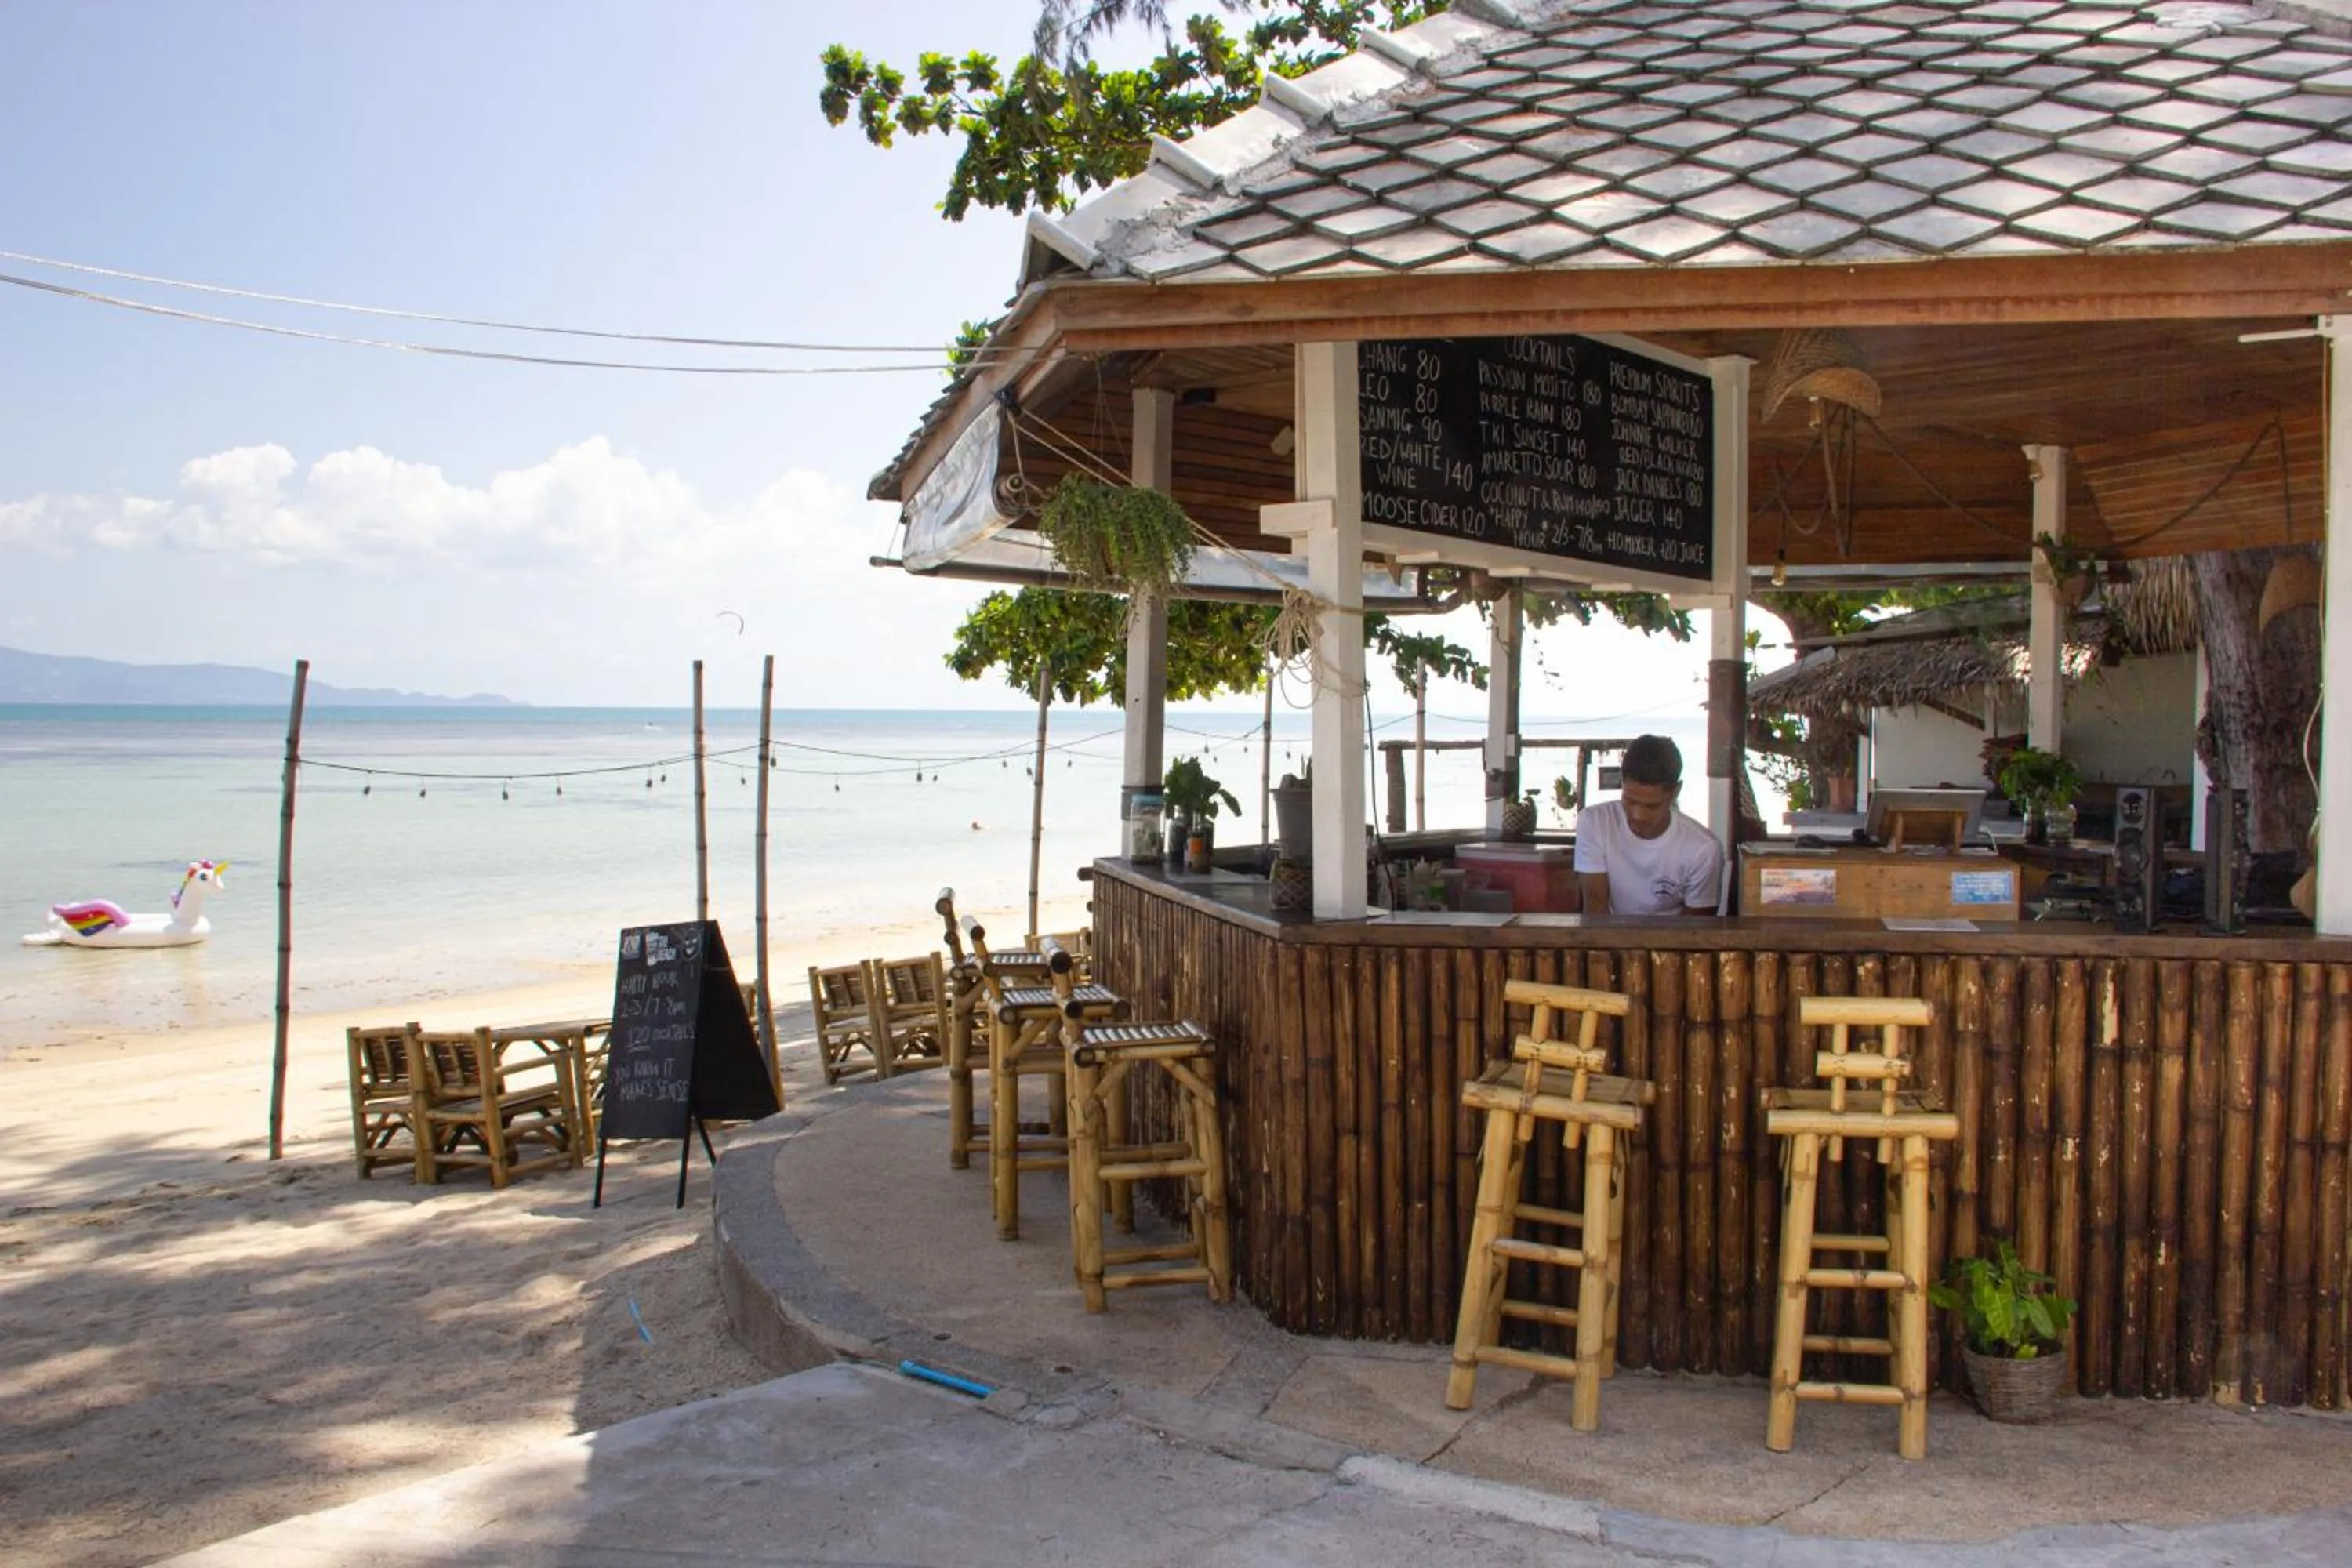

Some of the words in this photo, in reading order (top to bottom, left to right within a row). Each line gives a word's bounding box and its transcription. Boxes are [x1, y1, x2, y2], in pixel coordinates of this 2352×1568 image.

[1359, 343, 1408, 373] HANG
[1417, 349, 1441, 381] 80
[1504, 336, 1576, 376] COCKTAILS
[1415, 383, 1438, 414] 80
[1478, 358, 1526, 391] PASSION
[1534, 370, 1577, 401] MOJITO
[1582, 379, 1602, 406] 180
[1656, 371, 1700, 412] SPIRITS
[1421, 416, 1443, 442] 90
[1479, 390, 1521, 419] PURPLE
[1526, 397, 1555, 424] RAIN
[1562, 405, 1581, 431] 180
[1512, 422, 1562, 455] SUNSET
[1567, 437, 1587, 460] 140
[1375, 463, 1417, 489] WINE
[1445, 457, 1473, 492] 140
[1481, 450, 1542, 477] AMARETTO
[1545, 455, 1574, 485] SOUR
[1578, 463, 1596, 488] 180
[1613, 468, 1639, 495] JACK
[1481, 479, 1541, 510] COCONUT
[1541, 490, 1551, 510] &
[1613, 495, 1657, 527] JAGER
[1663, 504, 1683, 530] 140
[1361, 490, 1418, 524] MOOSE
[1420, 499, 1459, 529] CIDER
[1462, 506, 1486, 538] 120
[627, 1025, 650, 1046] 120
